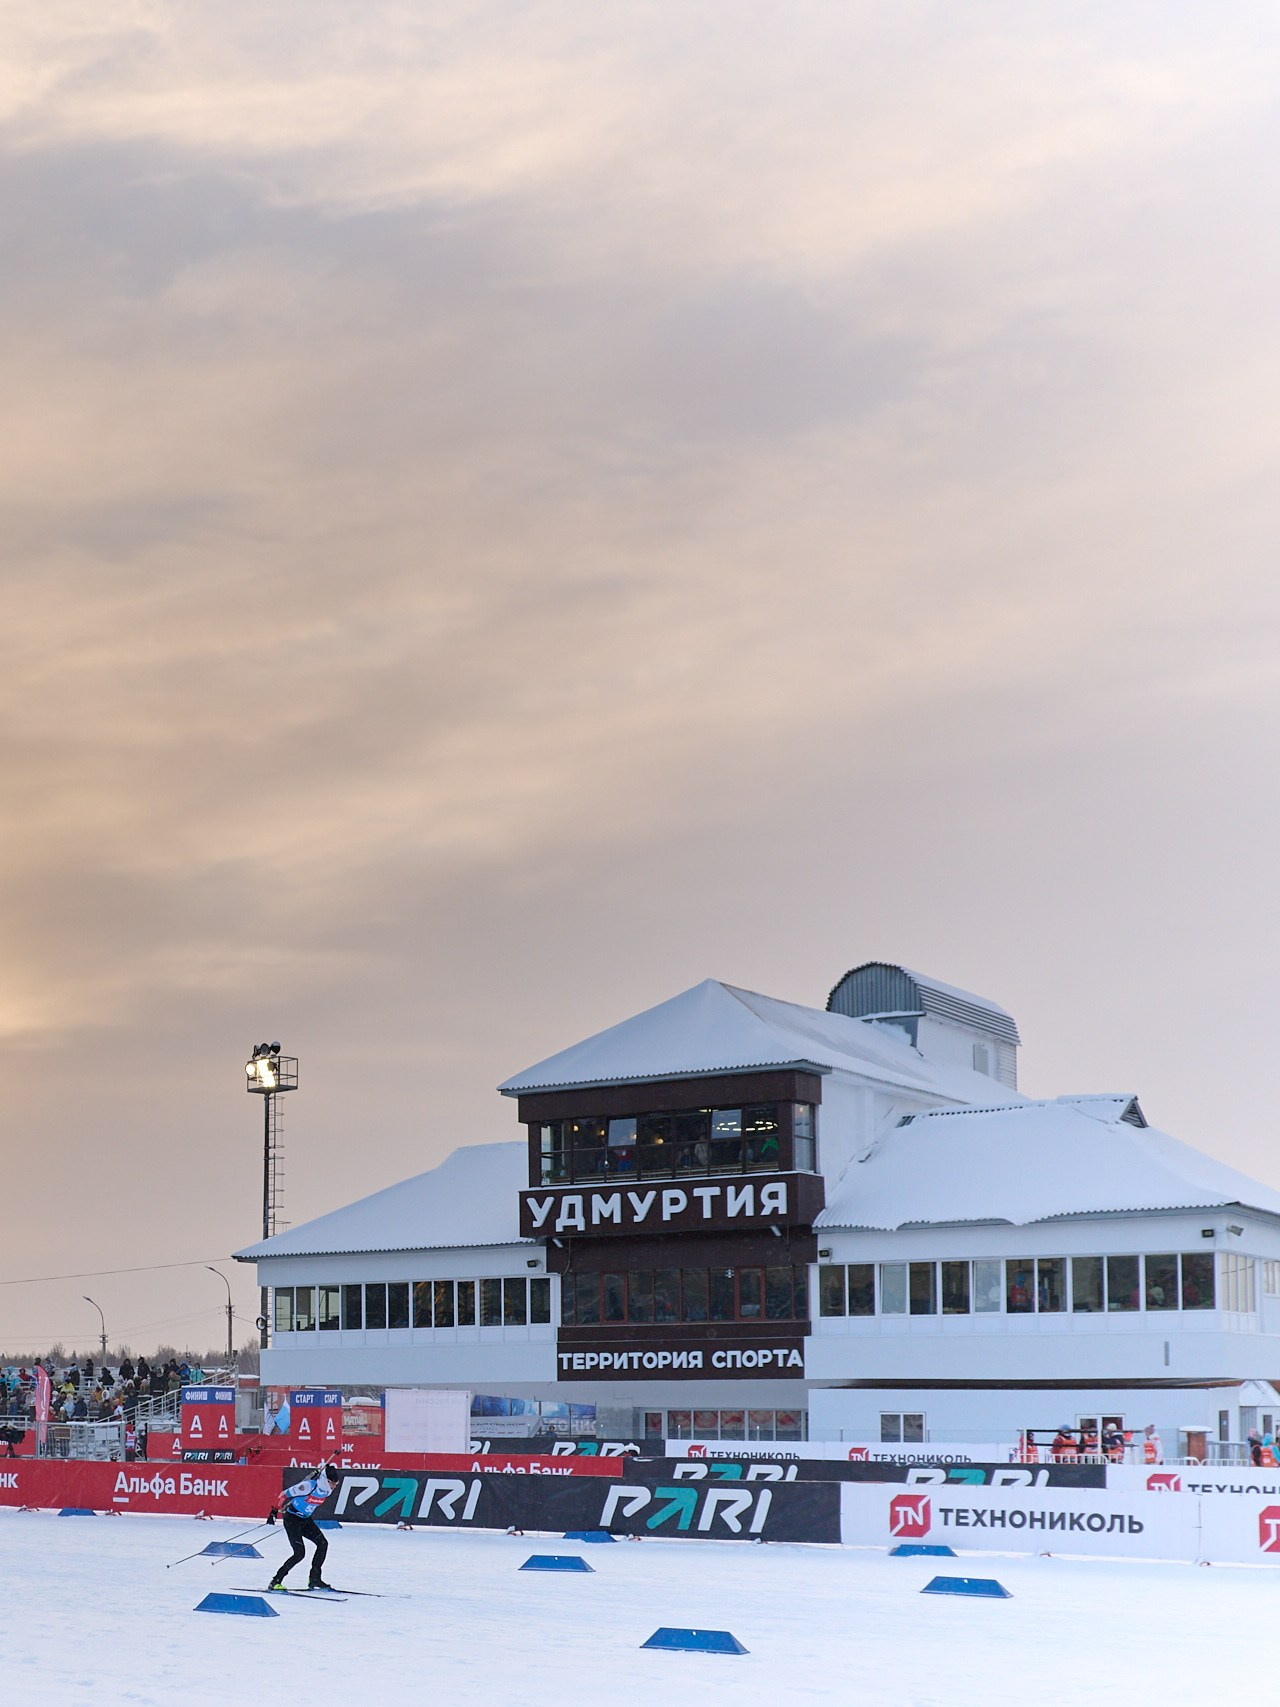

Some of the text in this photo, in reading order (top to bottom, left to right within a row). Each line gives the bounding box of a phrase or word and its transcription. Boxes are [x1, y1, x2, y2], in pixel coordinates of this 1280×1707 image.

[526, 1181, 788, 1233] УДМУРТИЯ
[558, 1348, 804, 1370] ТЕРРИТОРИЯ СПОРТА
[185, 1390, 208, 1401] ФИНИШ
[214, 1391, 232, 1401] ФИНИШ
[295, 1394, 314, 1404] СТАРТ
[324, 1394, 338, 1404] СТАРТ
[184, 1452, 208, 1461] PARI
[214, 1452, 233, 1461] PARI
[710, 1451, 800, 1460] ТЕХНОНИКОЛЬ
[873, 1453, 971, 1463] ТЕХНОНИКОЛЬ
[113, 1471, 229, 1500] Альфа Банк
[1187, 1483, 1280, 1494] ТЕХНОН
[333, 1475, 482, 1521] PARI
[599, 1484, 773, 1534] PARI
[939, 1507, 1145, 1534] ТЕХНОНИКОЛЬ
